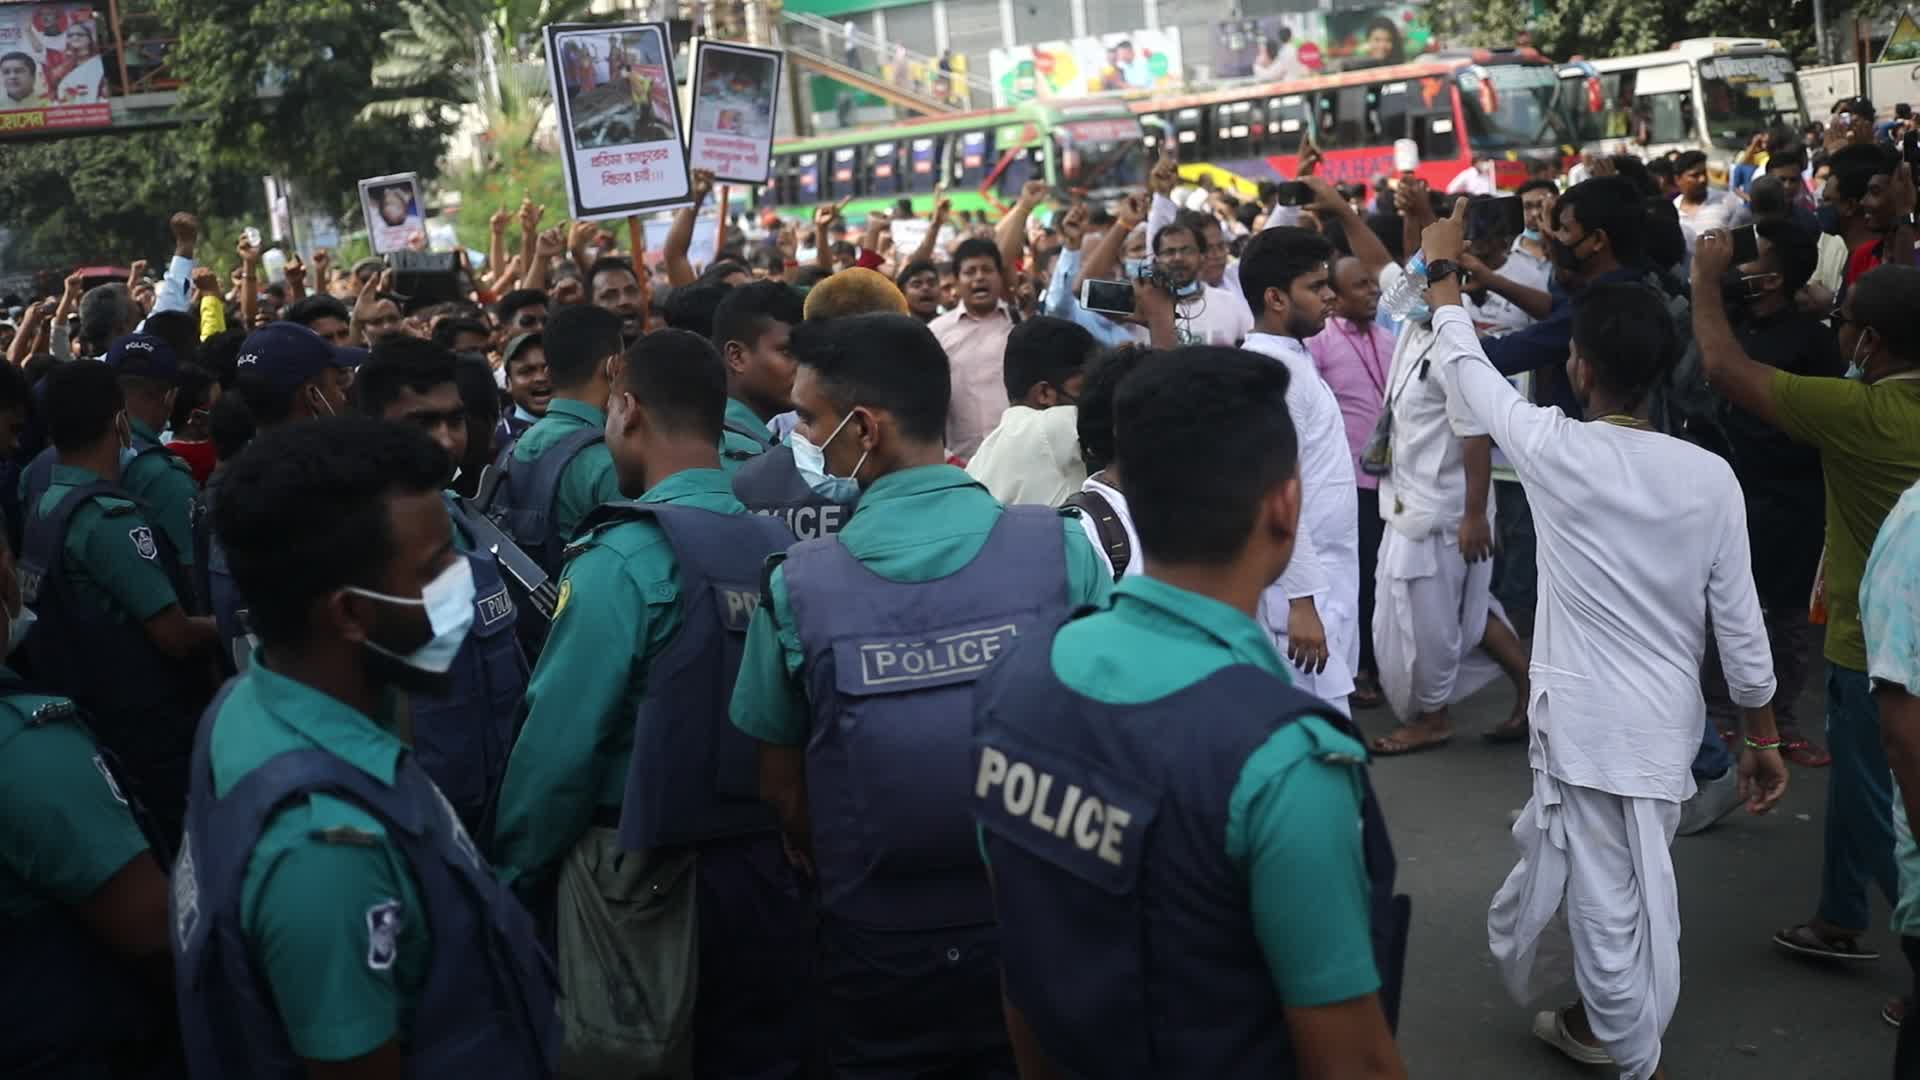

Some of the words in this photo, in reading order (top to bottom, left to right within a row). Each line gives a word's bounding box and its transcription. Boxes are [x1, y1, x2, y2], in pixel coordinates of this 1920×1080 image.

[125, 341, 154, 352] POLICE
[875, 635, 1001, 675] POLICE
[975, 746, 1132, 866] POLICE
